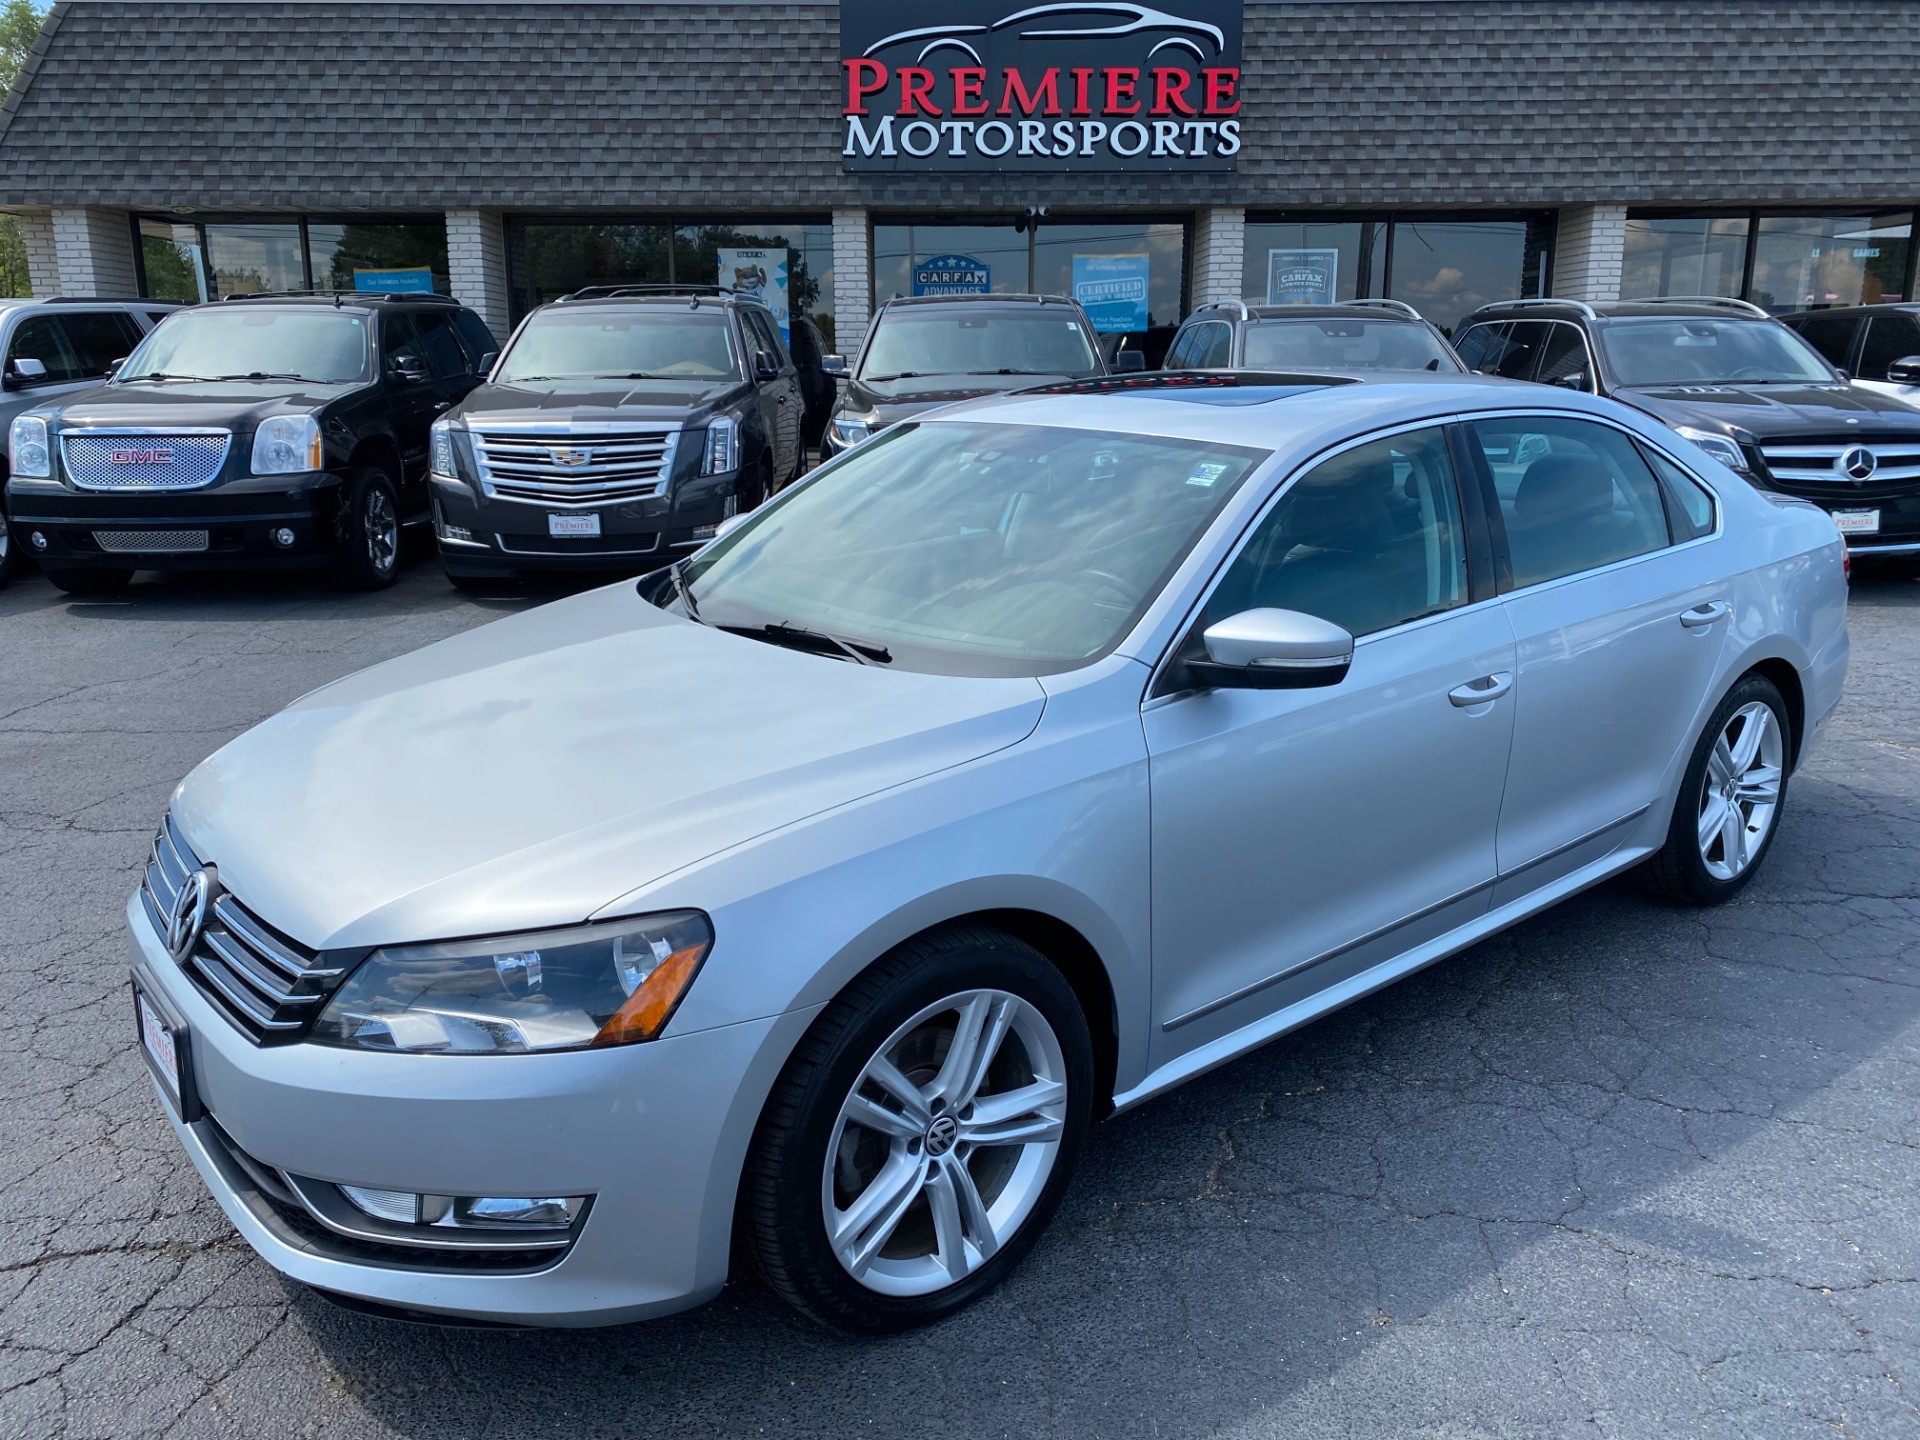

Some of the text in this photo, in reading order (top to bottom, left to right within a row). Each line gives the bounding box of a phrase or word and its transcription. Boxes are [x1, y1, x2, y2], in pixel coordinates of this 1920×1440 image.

[843, 59, 1242, 117] PREMIERE
[843, 115, 1241, 157] MOTORSPORTS
[919, 272, 984, 284] CARFAX
[1281, 273, 1323, 283] CARFAX
[1079, 281, 1142, 296] CERTIFIED
[111, 449, 172, 464] GMC
[554, 521, 595, 529] PREMIERE
